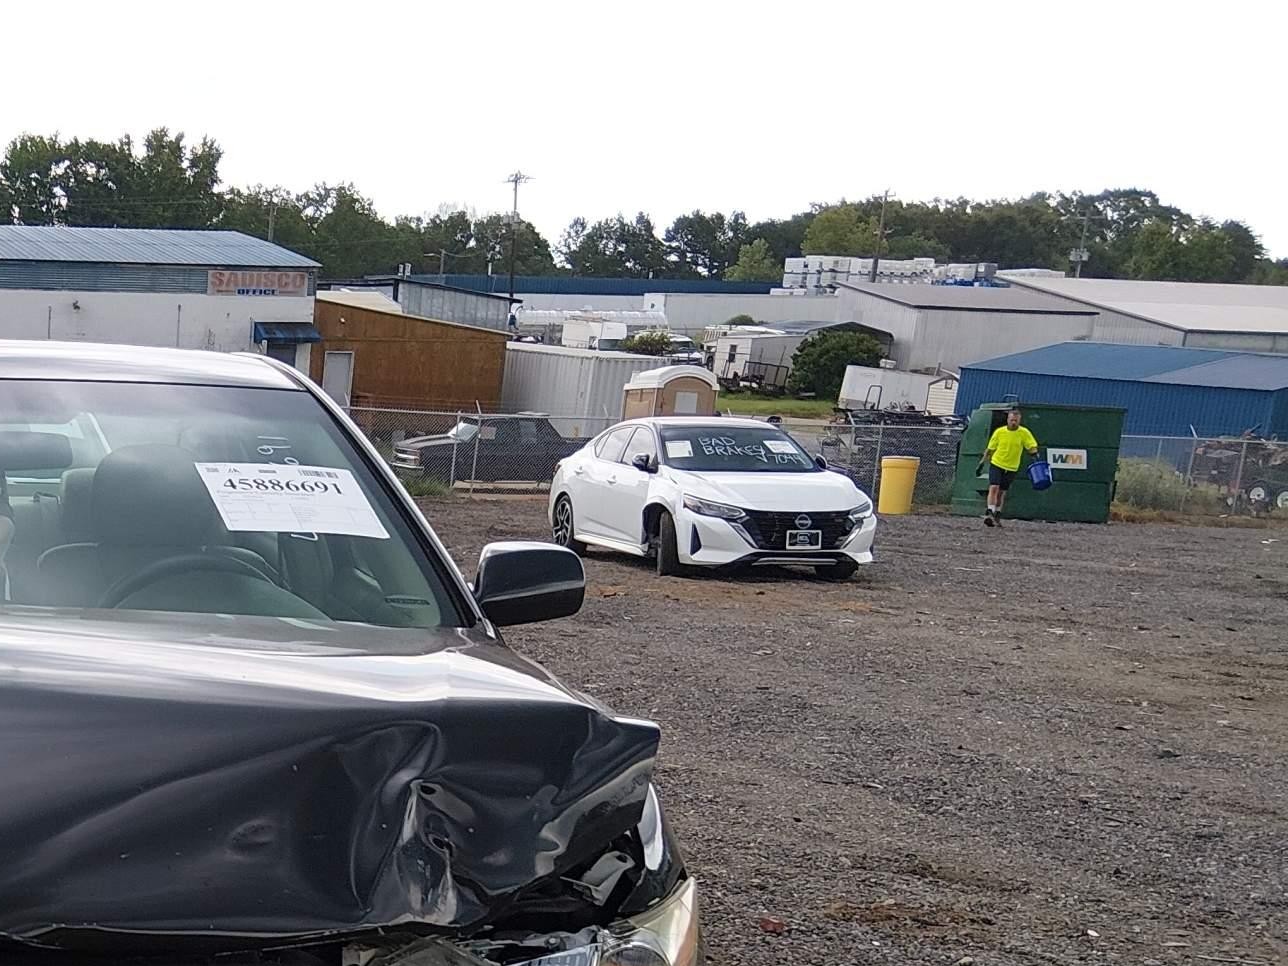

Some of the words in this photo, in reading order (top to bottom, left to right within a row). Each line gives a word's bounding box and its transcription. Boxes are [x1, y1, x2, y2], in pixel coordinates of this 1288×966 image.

[212, 271, 306, 289] SADISCO
[237, 288, 279, 296] OFFICE
[1052, 453, 1083, 465] WM
[223, 477, 344, 496] 45886691
